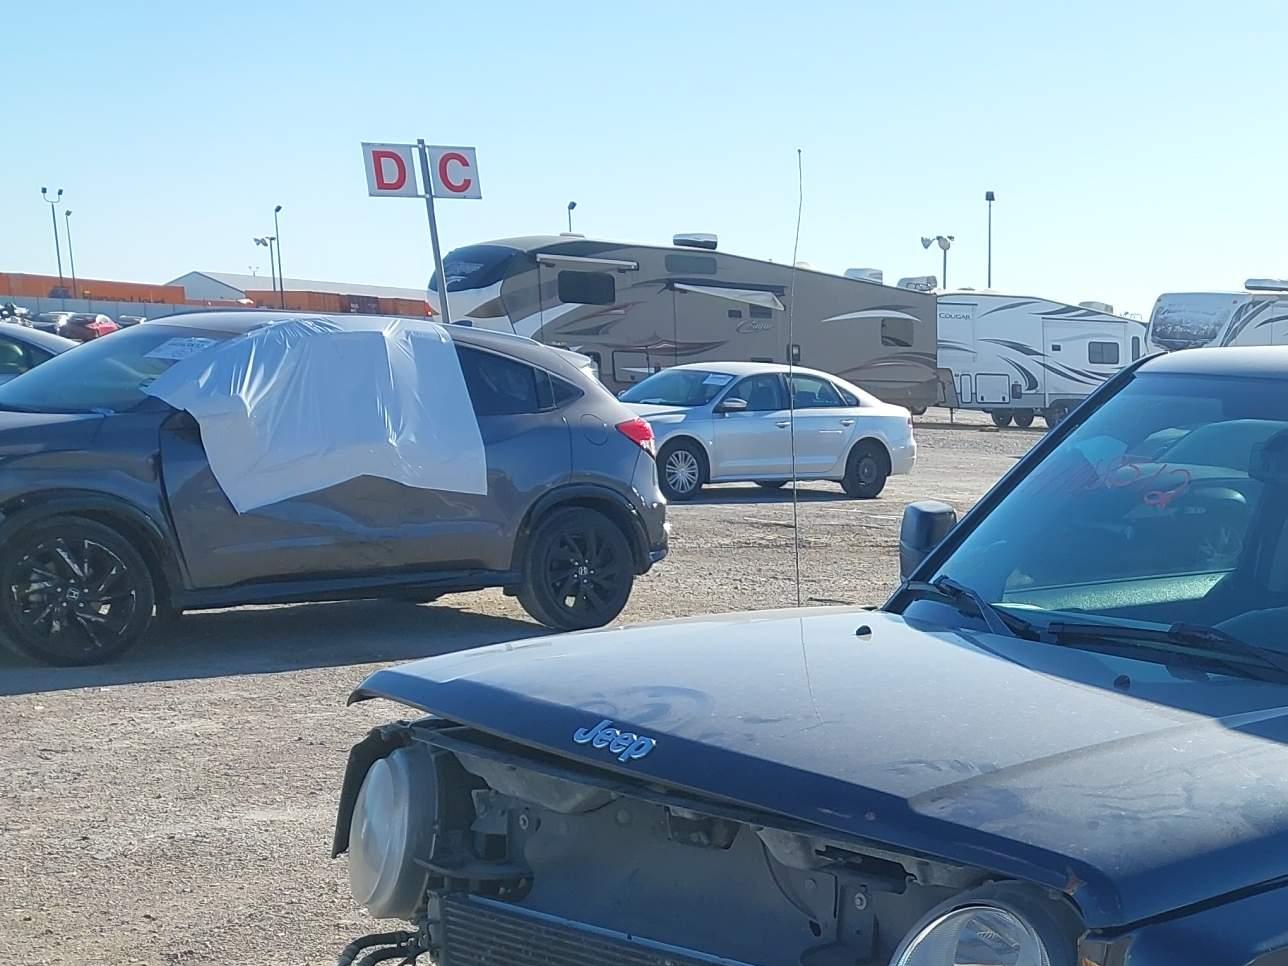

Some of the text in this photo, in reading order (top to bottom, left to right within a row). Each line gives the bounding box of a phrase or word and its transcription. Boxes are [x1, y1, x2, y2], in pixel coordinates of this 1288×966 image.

[372, 150, 407, 191] D
[438, 152, 472, 193] C
[573, 719, 657, 762] Jeep
